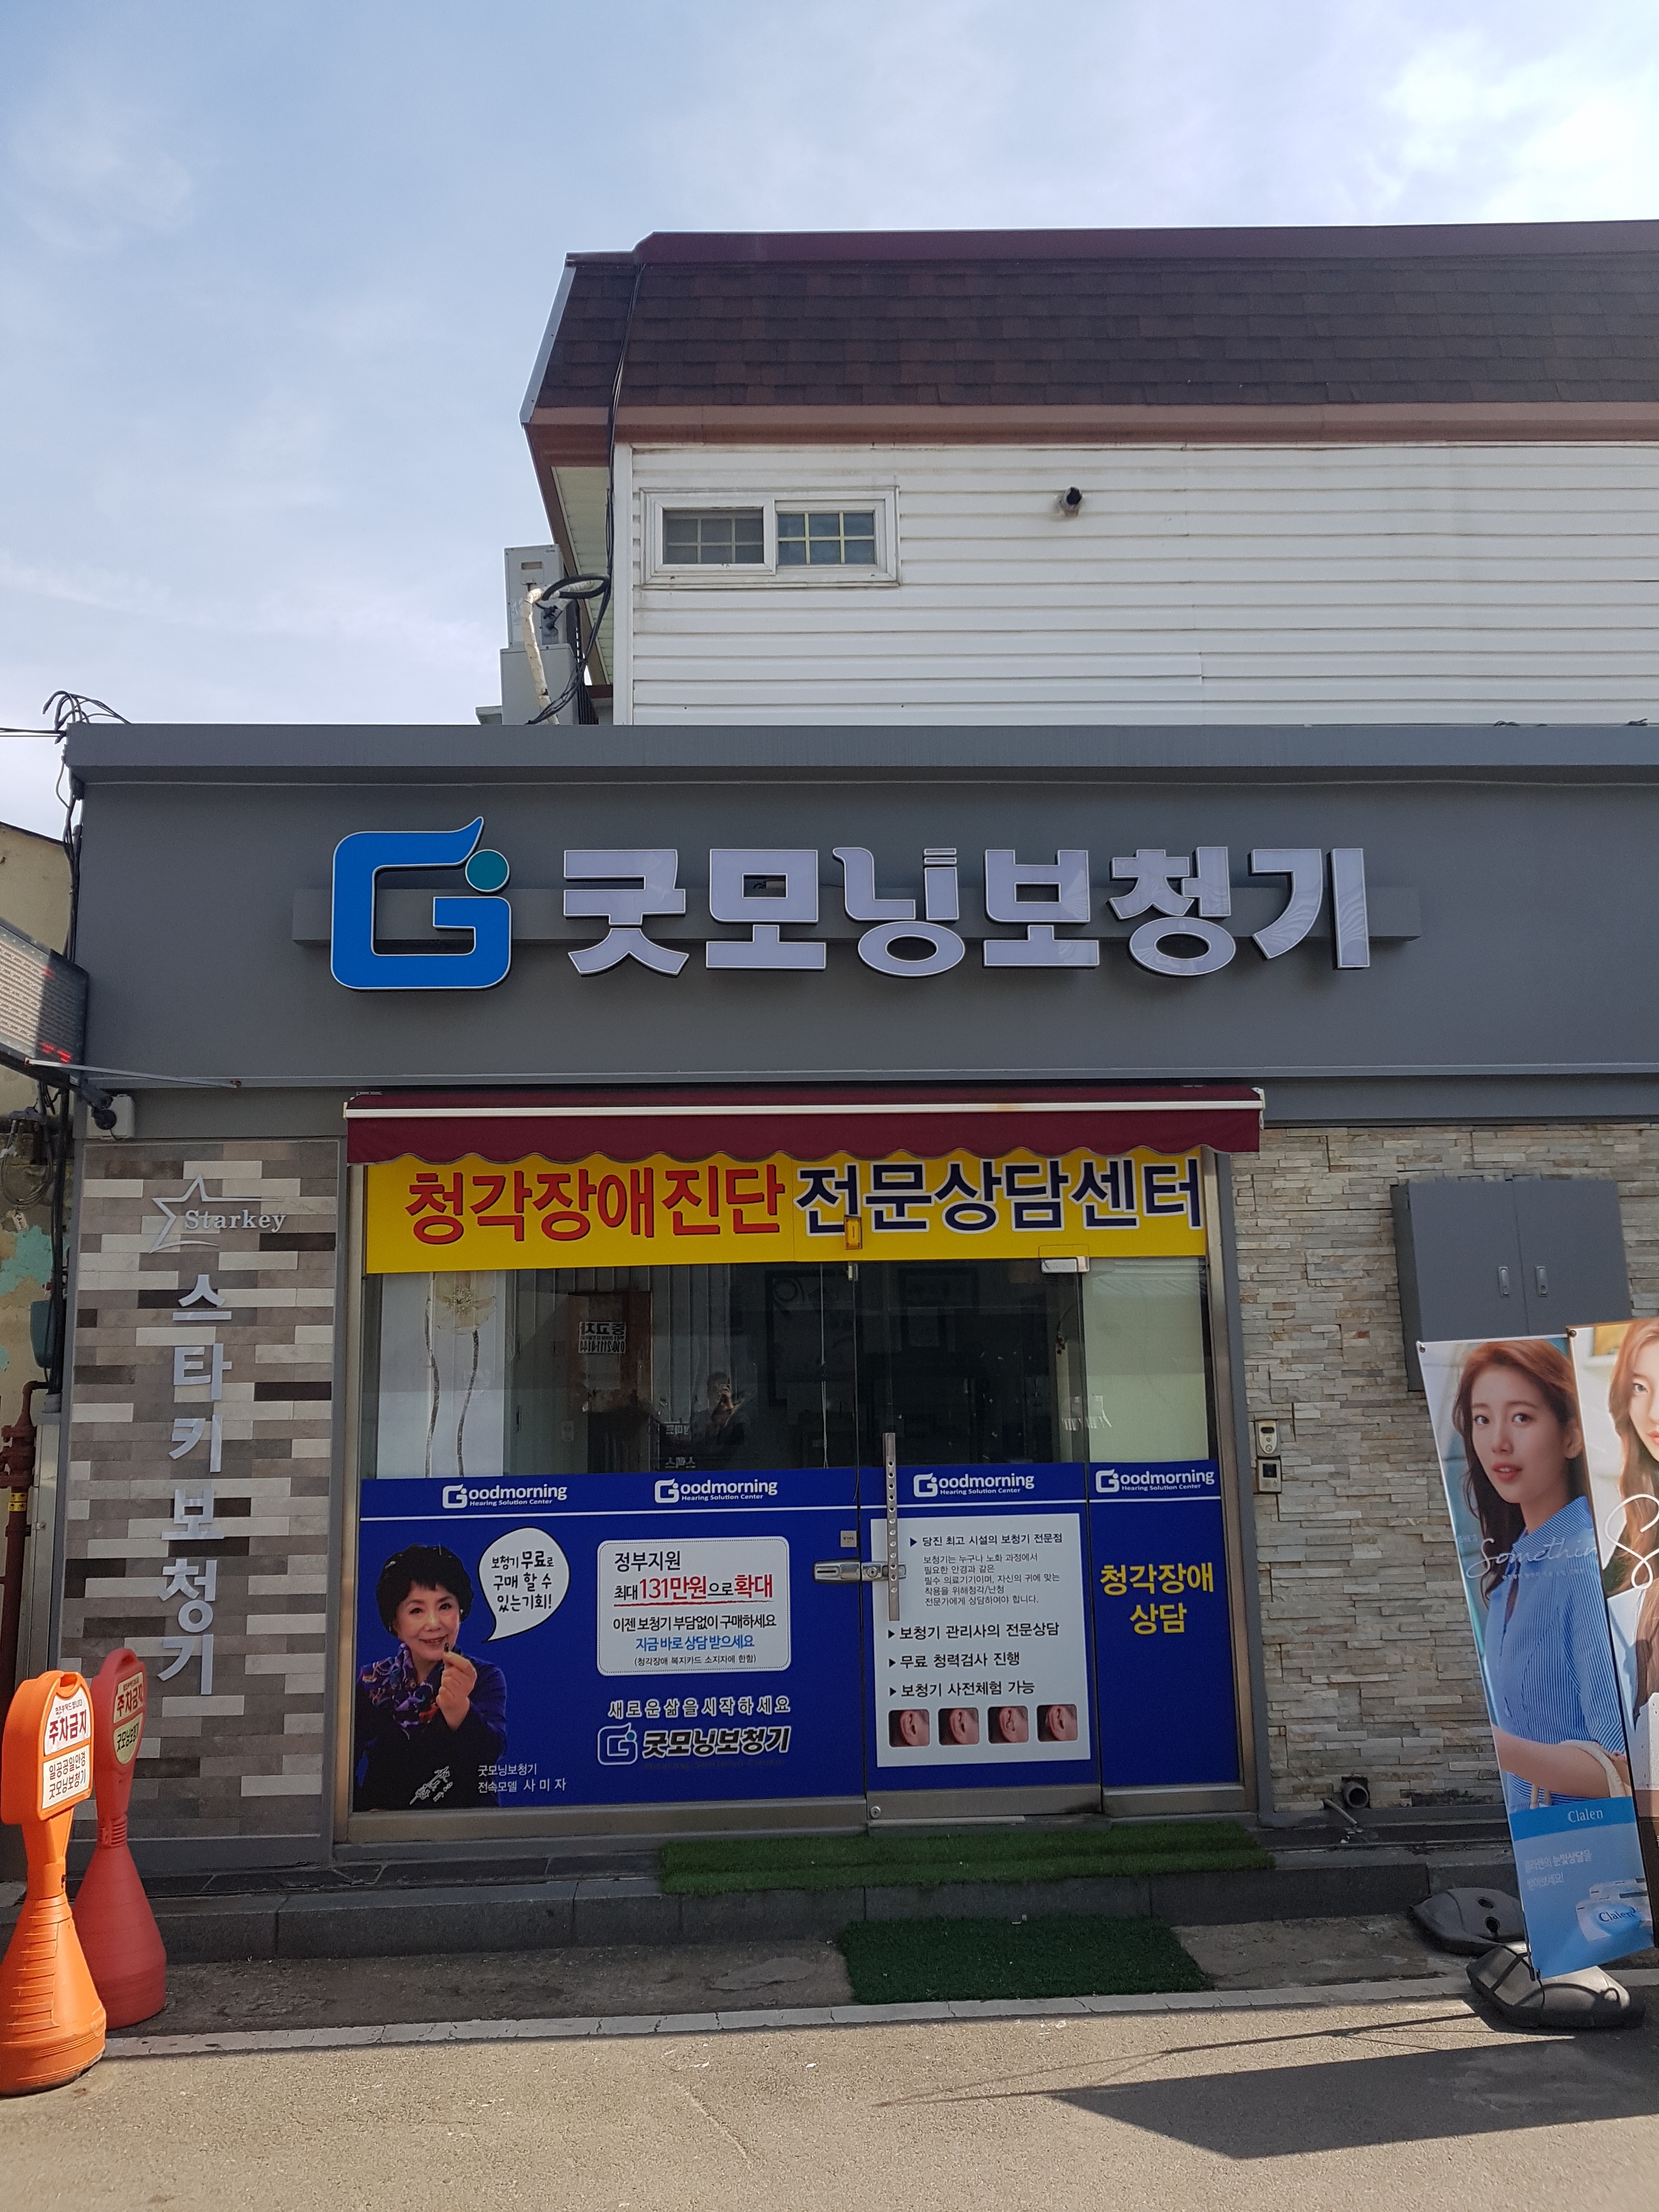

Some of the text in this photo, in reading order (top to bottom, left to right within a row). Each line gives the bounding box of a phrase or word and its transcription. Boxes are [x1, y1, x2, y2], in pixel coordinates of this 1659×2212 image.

[563, 845, 1371, 978] 굿모닝보청기
[405, 1156, 1204, 1245] 청각장애진단 전문상담센터
[184, 1210, 286, 1233] Starkey
[157, 1274, 233, 1695] 스타키보청기
[654, 1478, 777, 1503] Goodmorning
[913, 1472, 1034, 1497] Goodmorning
[1096, 1469, 1215, 1493] Goodmorning
[442, 1483, 567, 1509] Goodmorning
[922, 1533, 1063, 1547] 당진 최고 시설의 보청기 전문점
[491, 1550, 554, 1570] 보청기 무료로
[614, 1550, 681, 1572] 정부지원
[923, 1553, 1037, 1565] 보청기는 누구나 노화 과정에서
[924, 1565, 995, 1575] 필요한 안경과 같은
[924, 1576, 940, 1585] 필수
[997, 1574, 1022, 1583] 자신의
[1025, 1573, 1040, 1582] 귀에
[1043, 1573, 1060, 1582] 맞는
[1100, 1562, 1214, 1595] 청각장애
[493, 1572, 552, 1592] 구매 할 수
[614, 1585, 638, 1600] 최대
[734, 1574, 772, 1599] 확대
[497, 1593, 551, 1613] 있는기회!
[925, 1597, 966, 1606] 전문가에게
[968, 1596, 1009, 1605] 상담하여야
[613, 1614, 777, 1632] 이젠 보청기 부담없이 구매하세요
[1130, 1602, 1187, 1635] 상담
[900, 1622, 1059, 1640] 보청기 관리사의 전문상담
[635, 1634, 755, 1652] 지금 바로 상담 받으세요
[634, 1654, 757, 1666] (청각장애 복지카드 소지자에 한함)
[900, 1651, 1020, 1669] 무료 청력검사 진행
[901, 1680, 1035, 1697] 보청기 사전체험 가능
[48, 1709, 87, 1746] 주차금지
[642, 1726, 791, 1759] 굿모닝보청기
[477, 1763, 537, 1776] 굿모닝보청기
[49, 1768, 86, 1800] 굿모닝보청기
[477, 1780, 517, 1793] 전속모델
[1568, 1809, 1604, 1822] Clalen
[1598, 1908, 1635, 1922] Clalen
